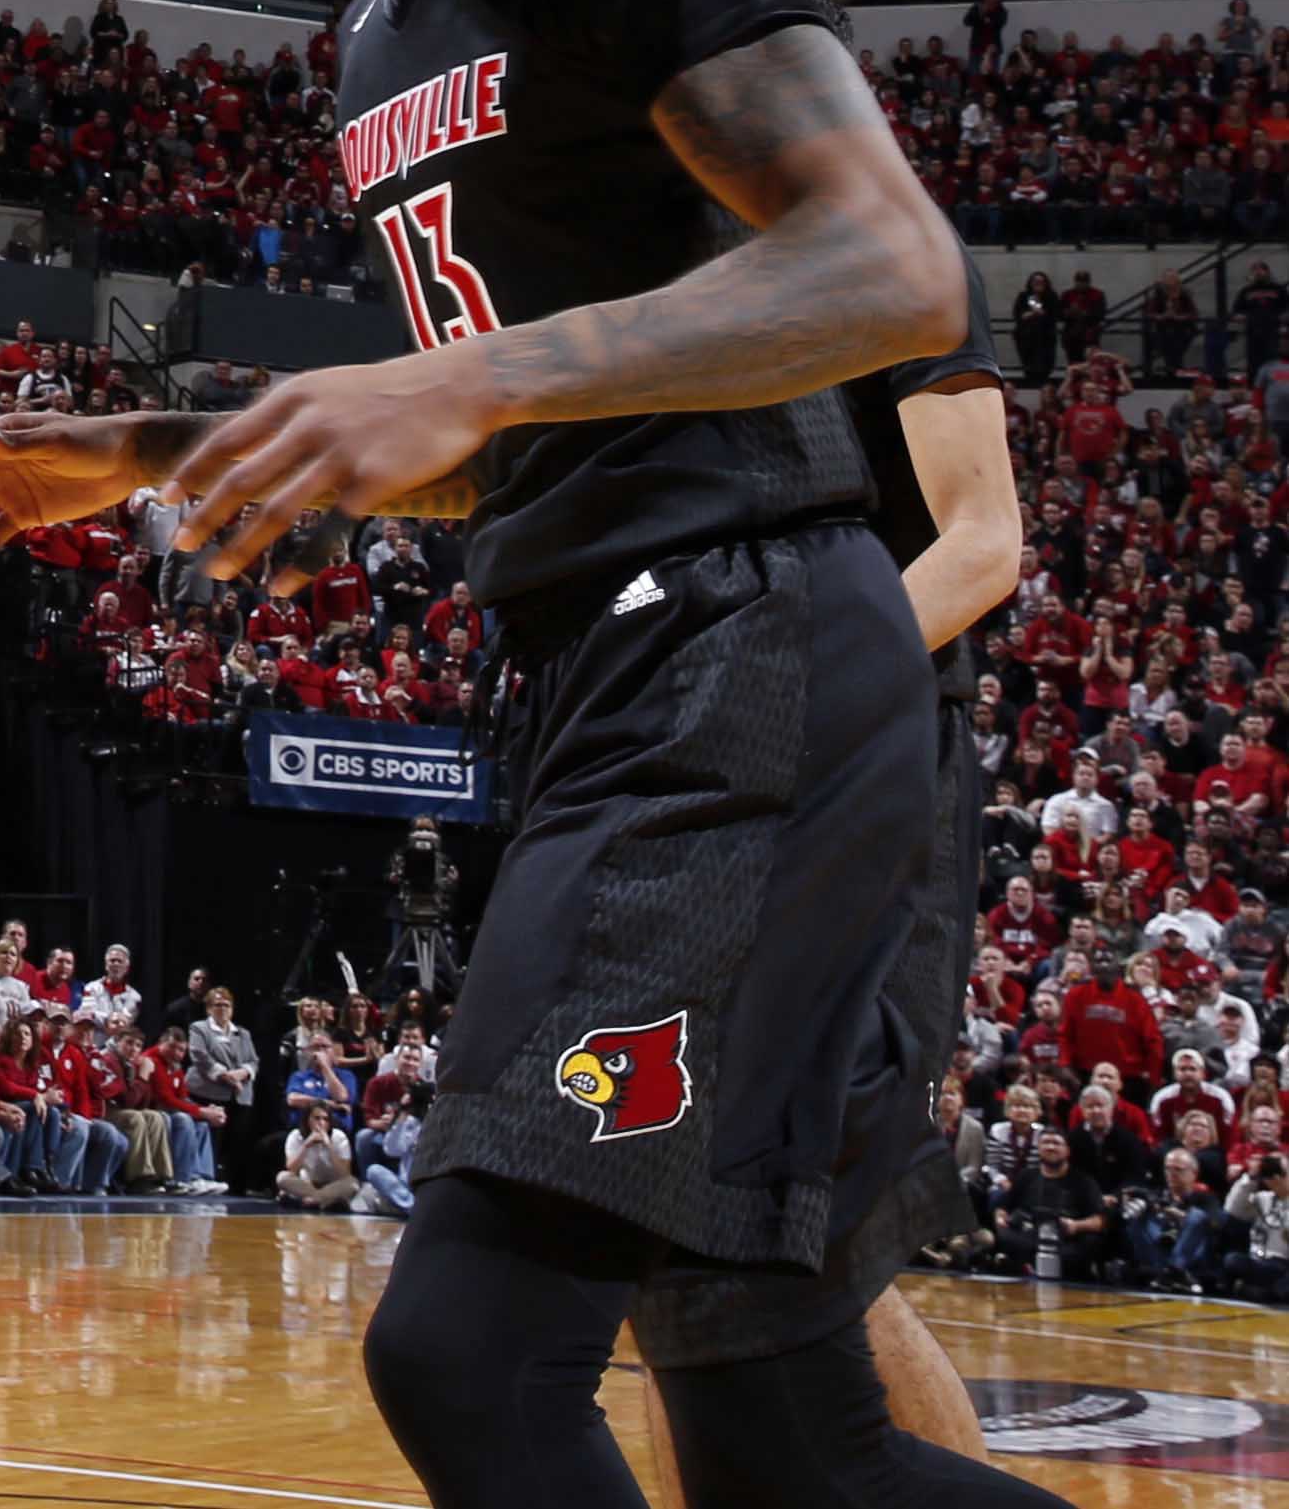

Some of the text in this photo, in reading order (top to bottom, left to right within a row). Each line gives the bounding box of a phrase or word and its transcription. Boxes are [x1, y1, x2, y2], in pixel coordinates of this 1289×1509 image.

[373, 181, 503, 351] 13
[318, 753, 463, 785] CBS SPORTS
